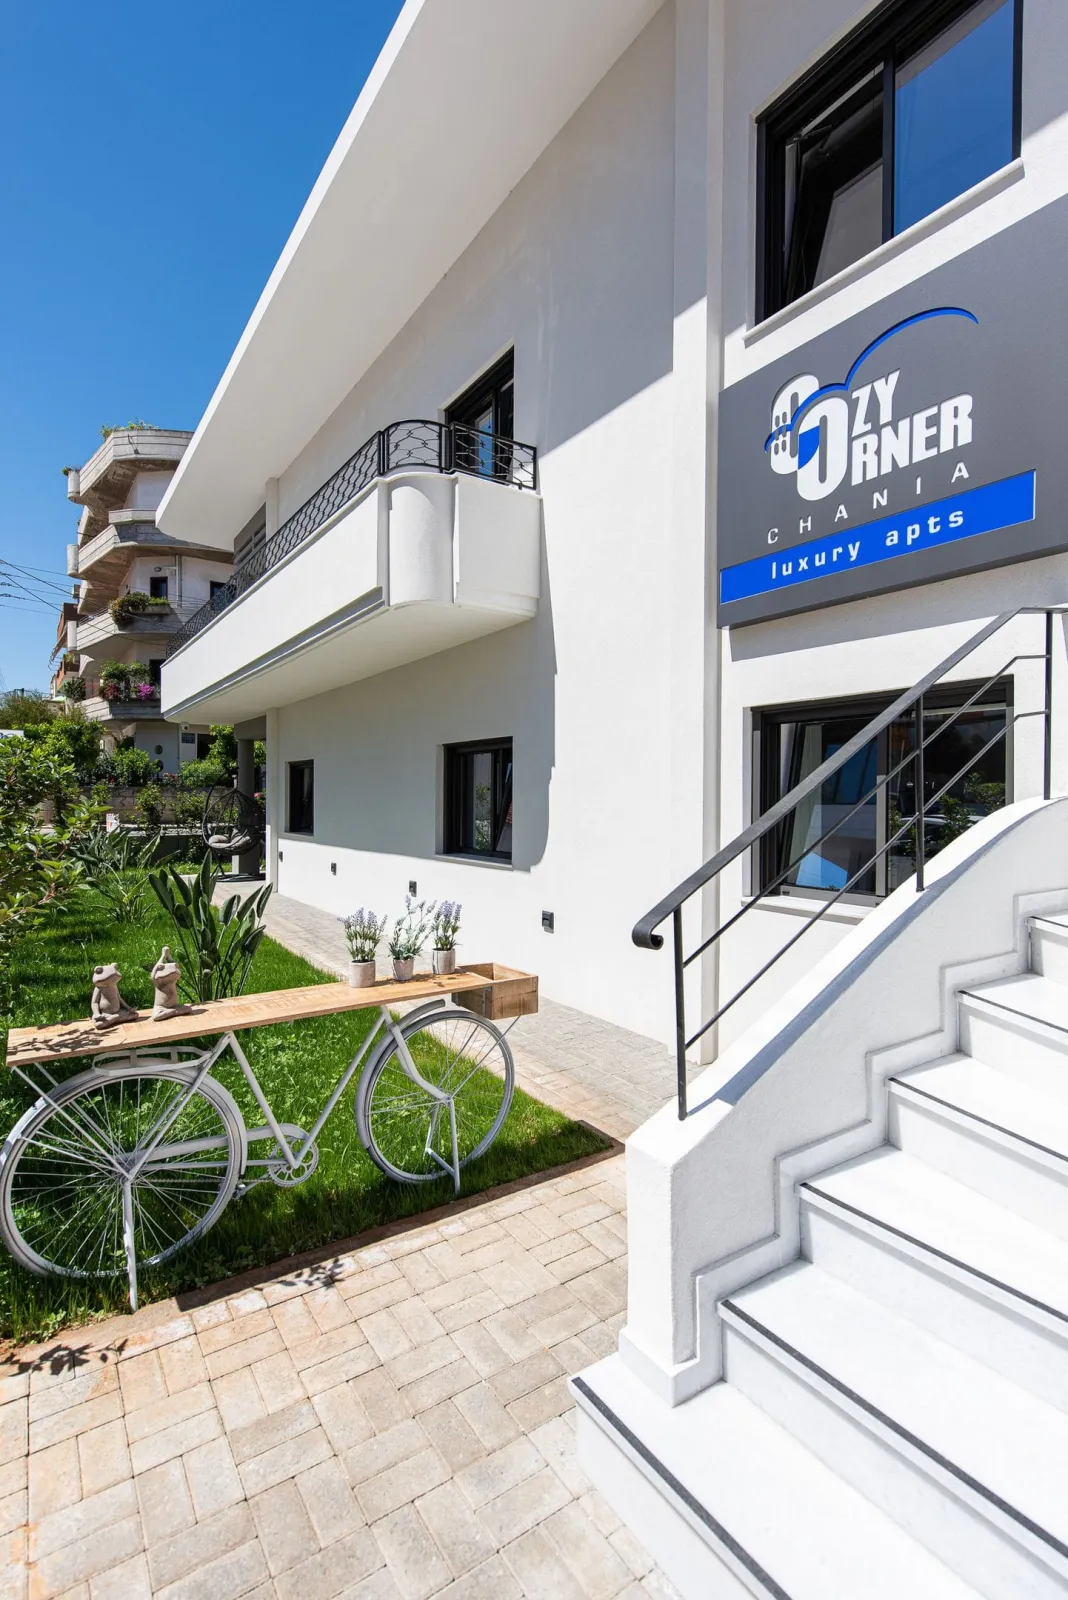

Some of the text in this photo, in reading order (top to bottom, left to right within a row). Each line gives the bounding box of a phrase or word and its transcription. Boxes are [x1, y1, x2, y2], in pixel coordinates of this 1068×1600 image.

[767, 462, 970, 544] CHANIA
[771, 510, 964, 579] luxury apts
